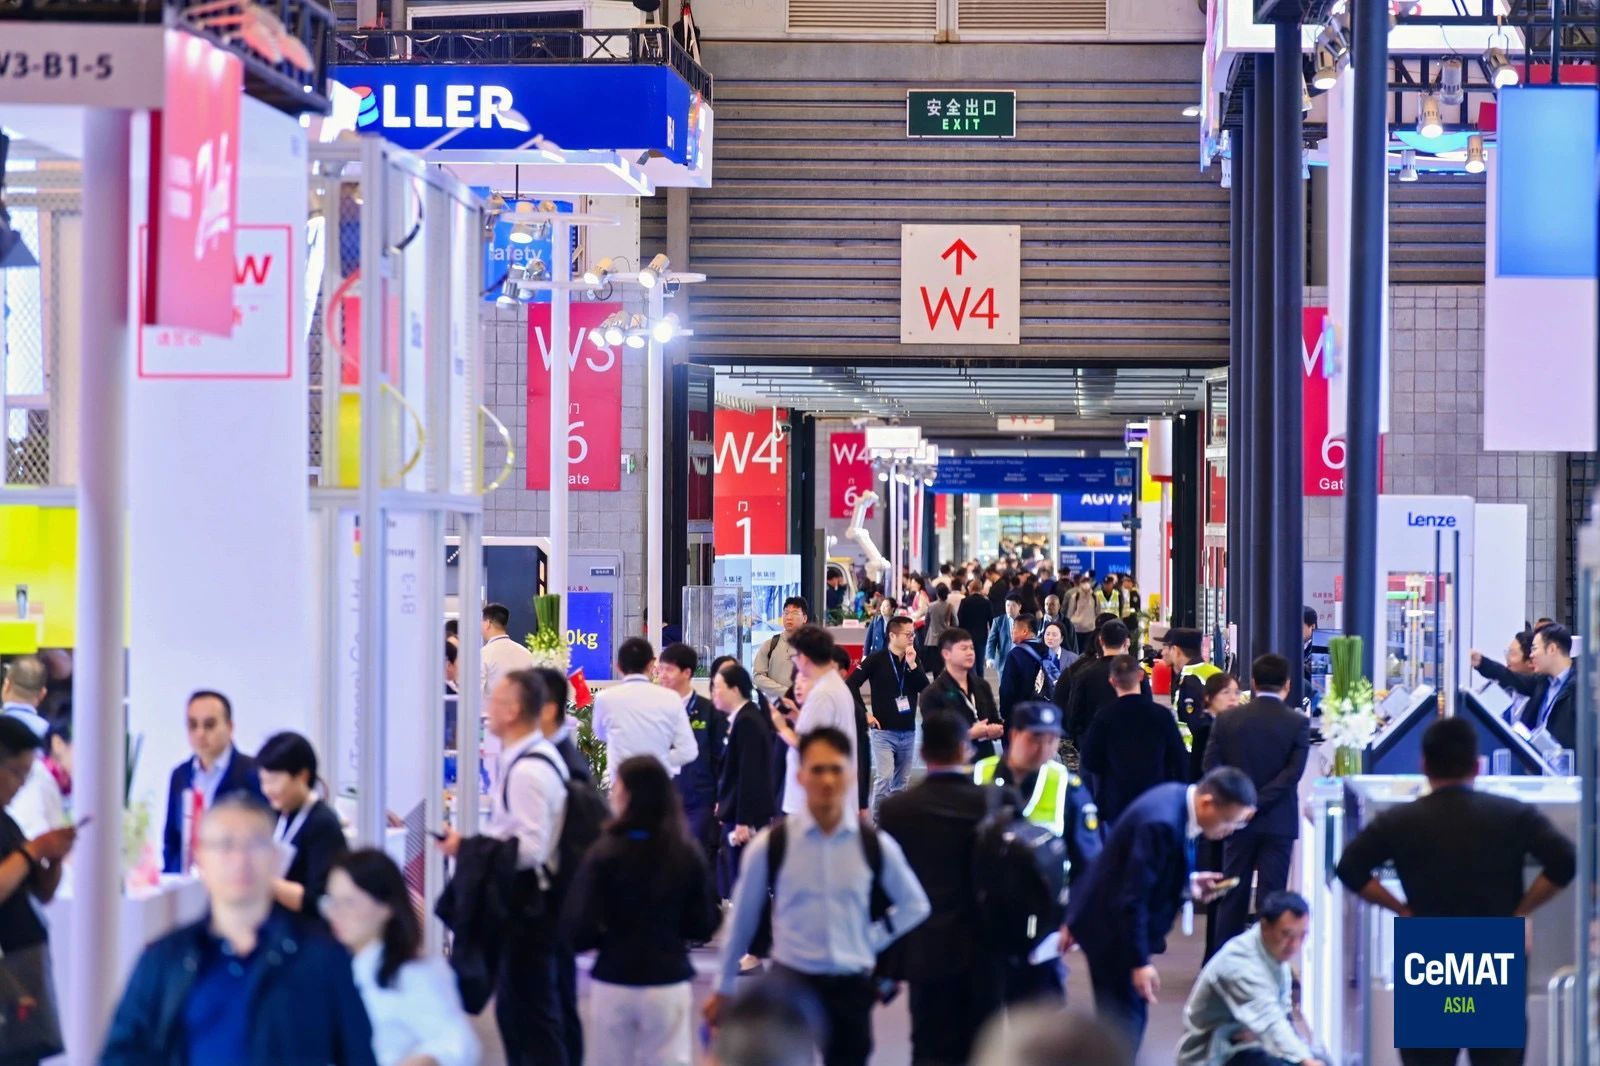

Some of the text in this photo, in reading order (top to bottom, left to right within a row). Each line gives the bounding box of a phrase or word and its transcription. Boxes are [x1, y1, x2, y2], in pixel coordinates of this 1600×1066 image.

[927, 98, 996, 116] 安全出口
[942, 118, 980, 130] EXIT
[920, 287, 1000, 331] W4
[714, 431, 782, 474] W4
[568, 474, 590, 485] ate
[1319, 478, 1344, 490] Gat
[1081, 493, 1114, 505] AGV
[1407, 511, 1456, 527] Lenze
[736, 517, 752, 555] 1
